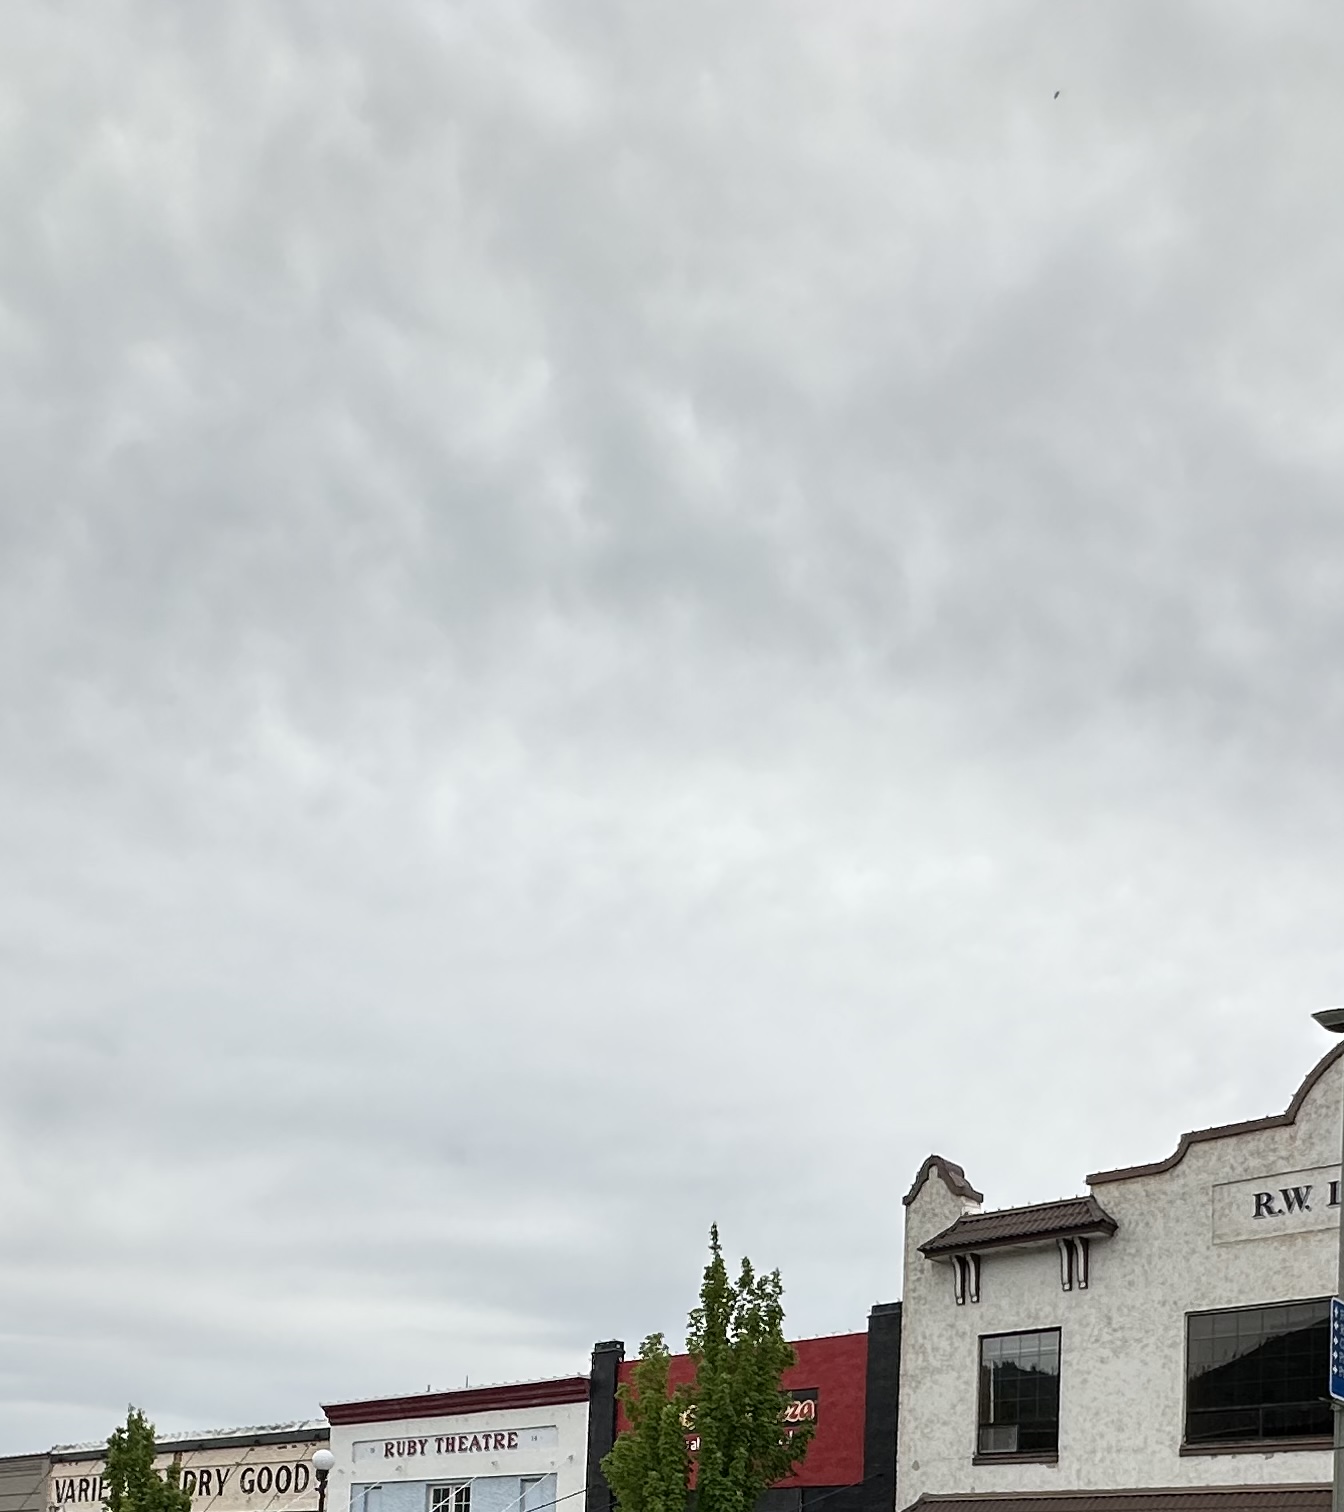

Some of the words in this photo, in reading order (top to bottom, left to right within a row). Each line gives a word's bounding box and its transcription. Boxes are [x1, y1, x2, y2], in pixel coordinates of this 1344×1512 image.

[1252, 1185, 1312, 1219] R.W.
[383, 1439, 428, 1458] RUBY
[435, 1432, 518, 1455] THEATRE
[56, 1477, 112, 1503] VARIE
[183, 1468, 230, 1496] DRY
[239, 1463, 310, 1494] GOOD
